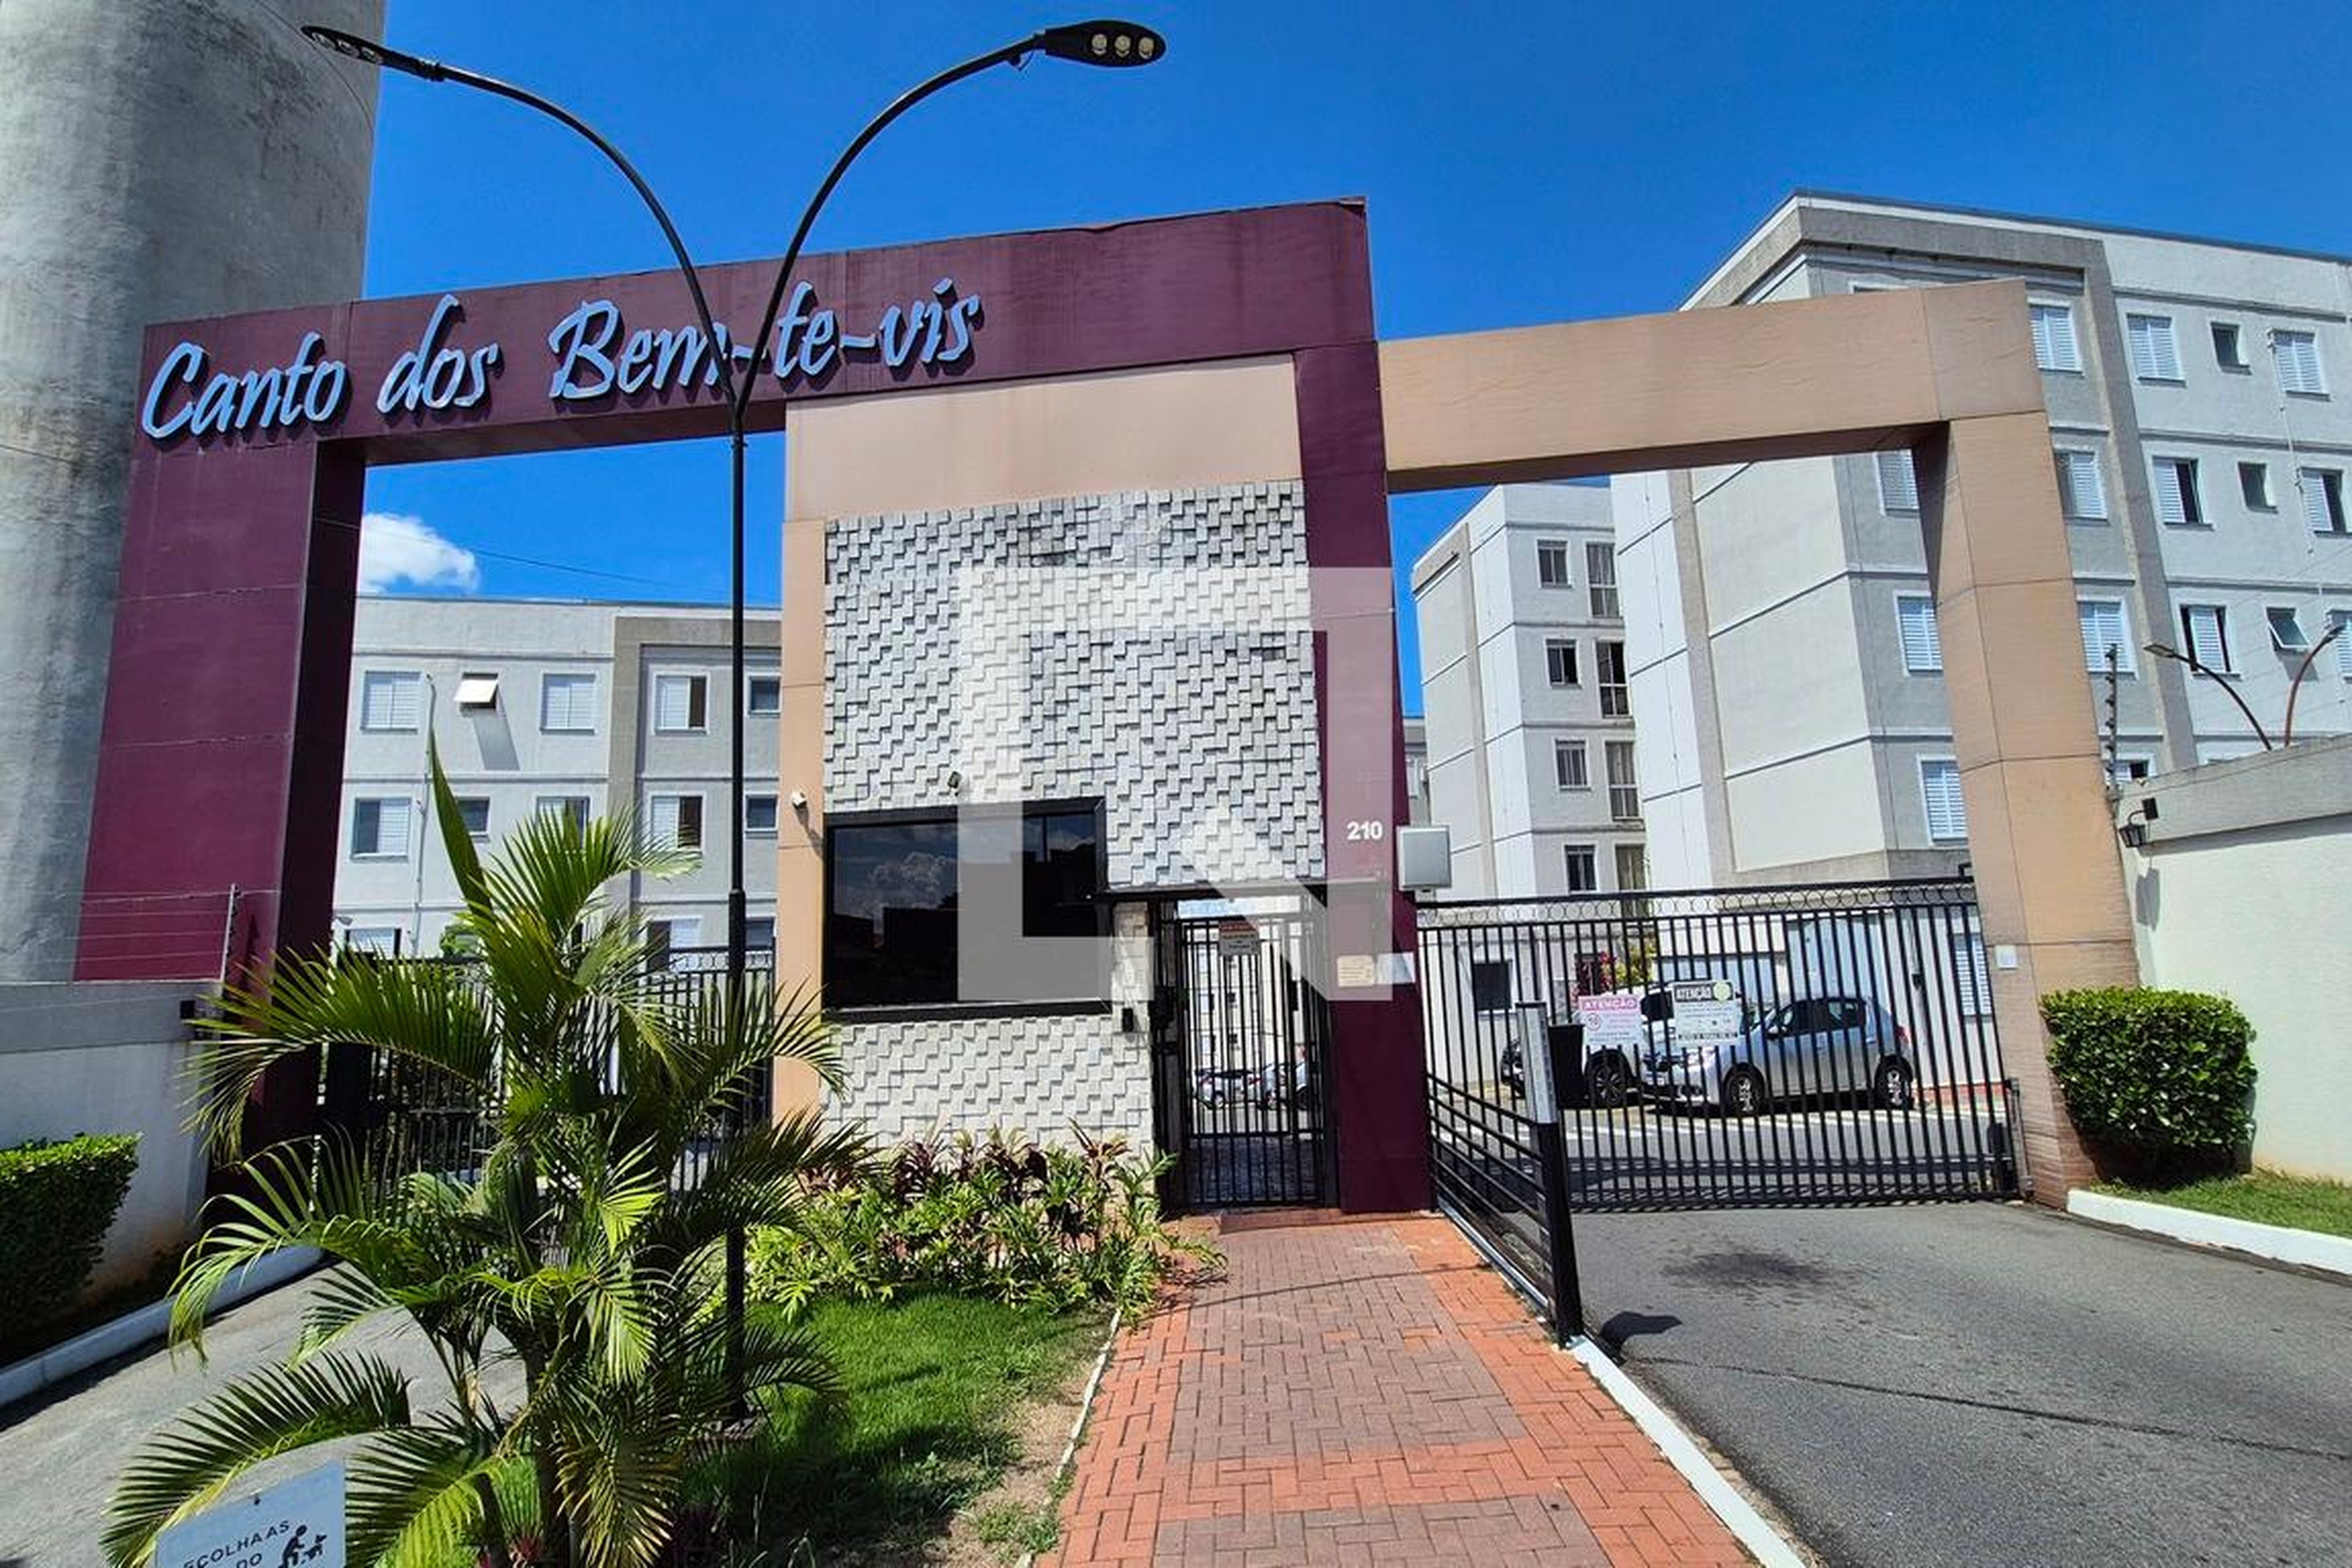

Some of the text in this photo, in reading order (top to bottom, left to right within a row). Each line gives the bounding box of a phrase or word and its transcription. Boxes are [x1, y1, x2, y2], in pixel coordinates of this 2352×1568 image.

[141, 277, 980, 439] Canto dos Bem-te-vis
[1347, 821, 1384, 841] 210
[183, 1532, 262, 1568] SCOLHA
[236, 1552, 263, 1568] DO
